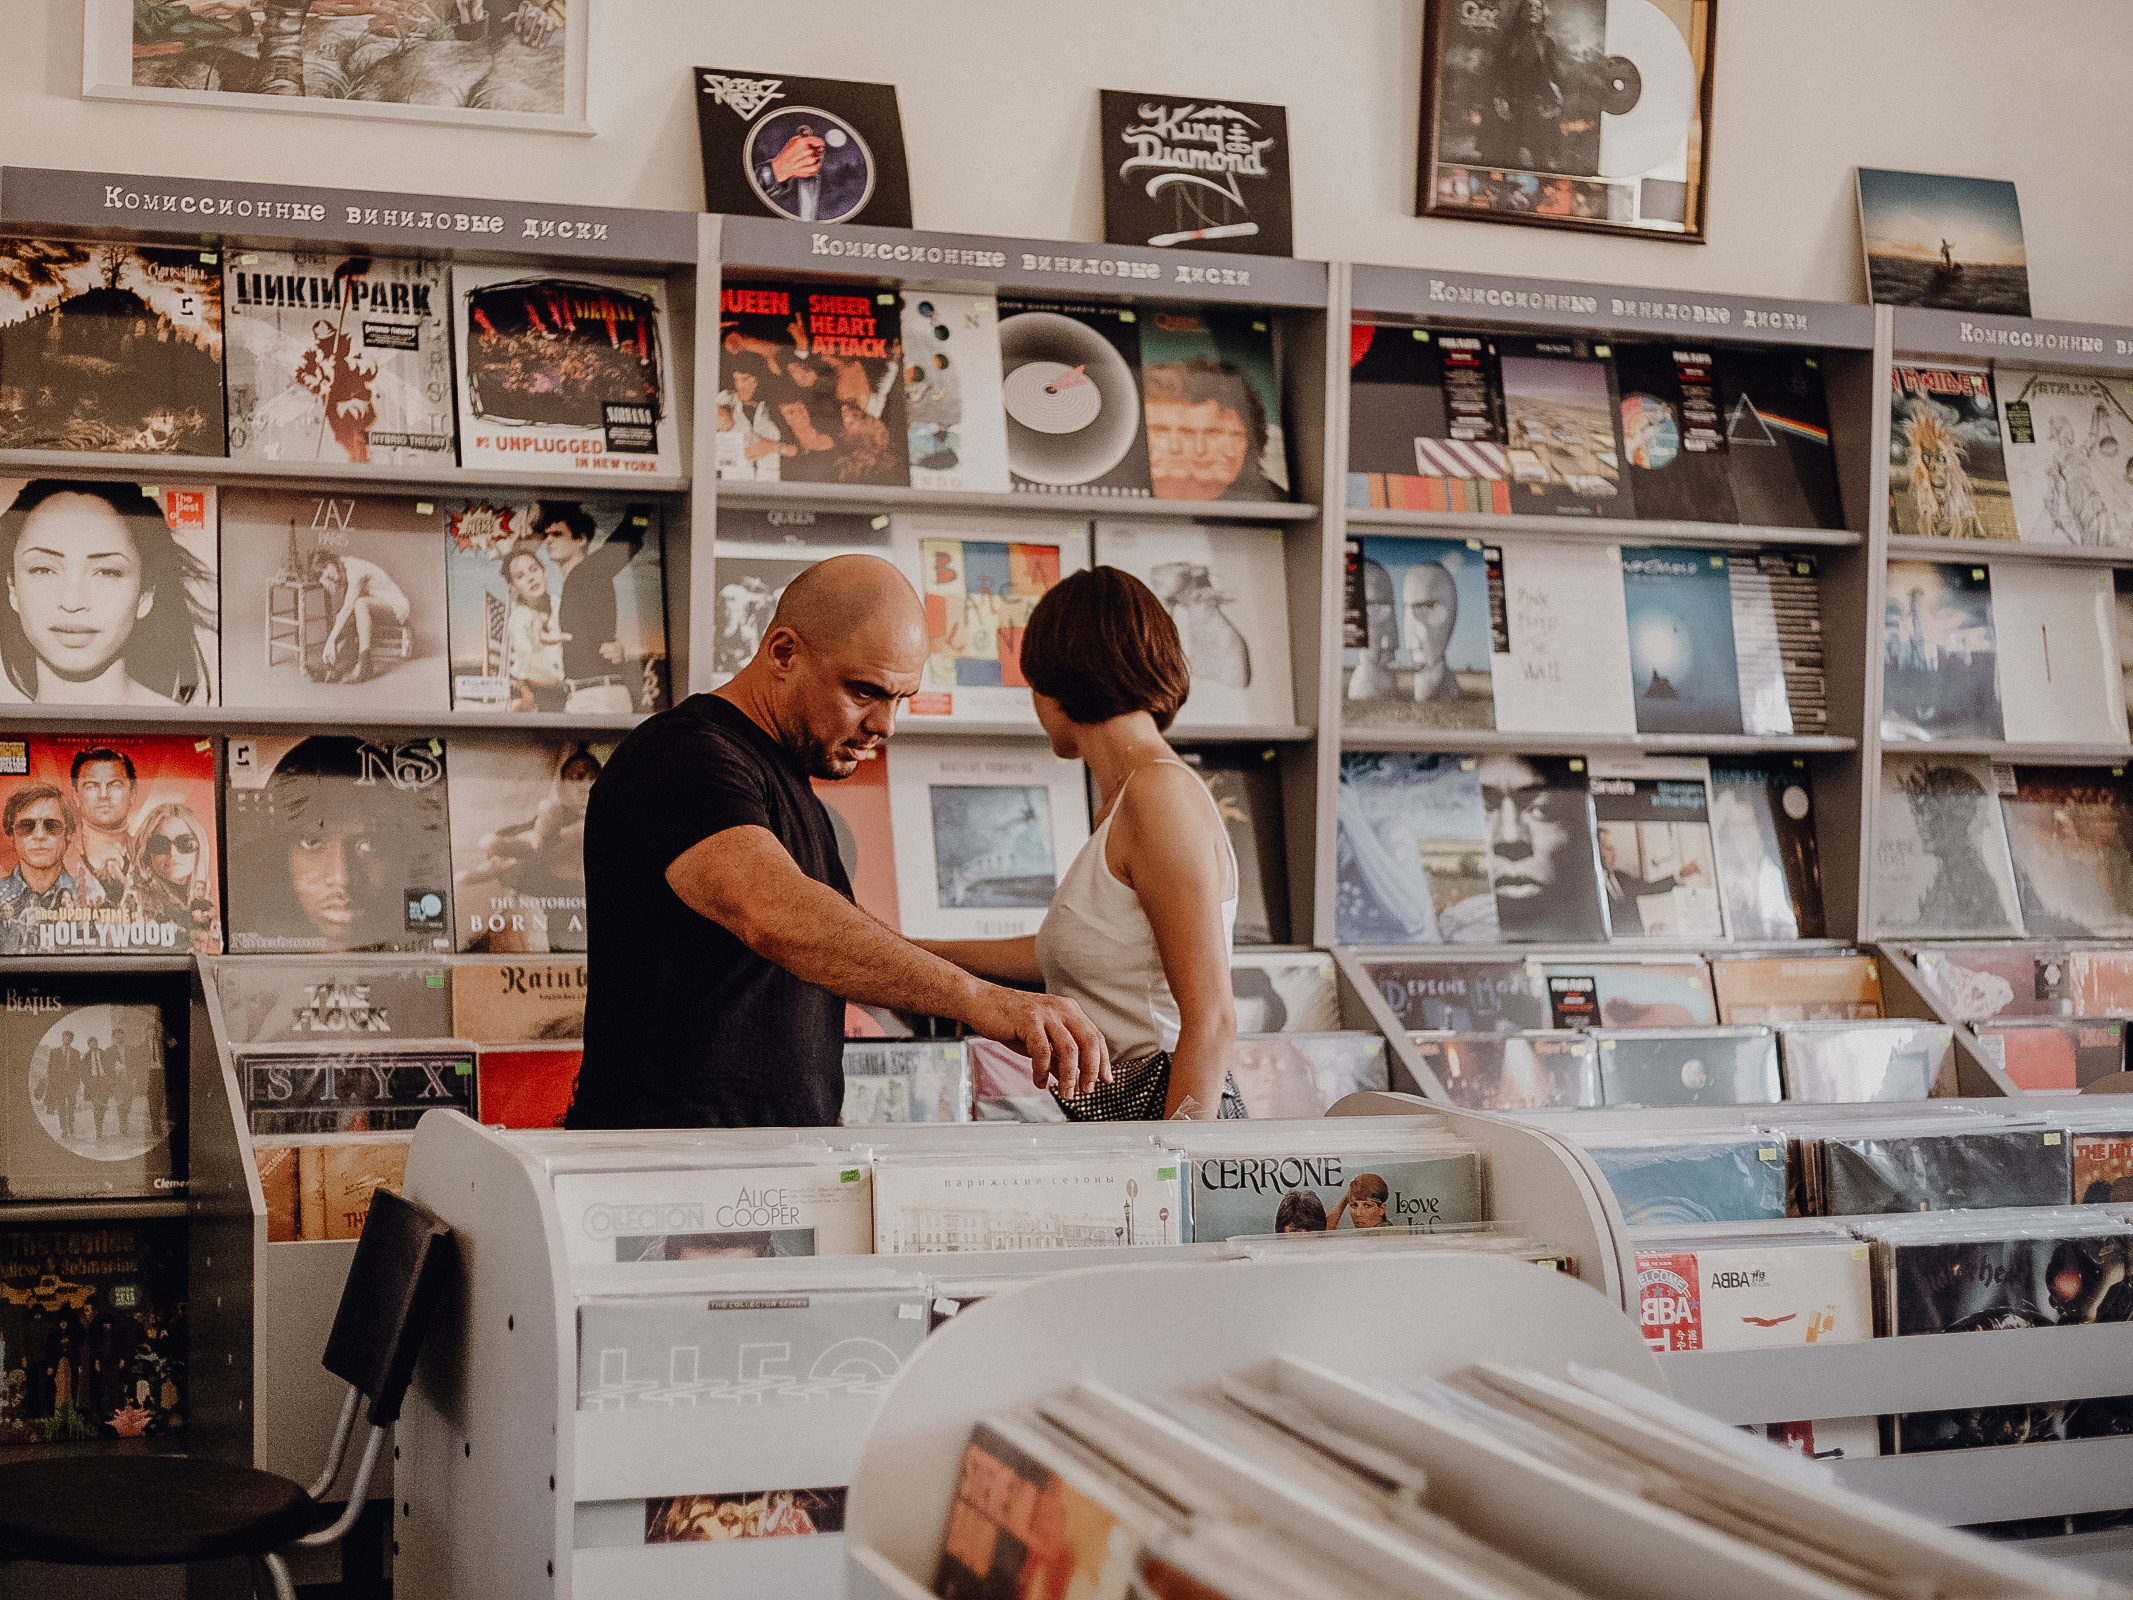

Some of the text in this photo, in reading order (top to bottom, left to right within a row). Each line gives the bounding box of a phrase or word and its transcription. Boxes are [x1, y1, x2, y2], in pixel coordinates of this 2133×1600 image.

[1125, 102, 1225, 151] King
[1119, 133, 1275, 178] Diamond
[103, 185, 610, 241] Комиссионные виниловые диски
[811, 233, 1251, 287] Комиссионные виниловые диски
[236, 272, 432, 317] LINKIN PARK
[808, 294, 871, 317] SHEER
[1428, 279, 1808, 332] Комиссионные виниловые диски
[809, 315, 877, 337] HEART
[1959, 322, 2104, 353] Комиссионные
[811, 336, 888, 359] ATTACK
[495, 436, 604, 455] UNPLUGGED
[592, 458, 620, 469] NEW
[624, 459, 657, 472] YORK
[489, 896, 587, 910] THE NOTORIO
[58, 907, 92, 921] UPON
[99, 908, 131, 924] TIME
[470, 913, 549, 933] BORN
[39, 920, 177, 949] HOLLYWOOD
[501, 966, 587, 994] Rainb
[6, 988, 62, 1016] BEATLES
[293, 1006, 391, 1032] FLOCK
[267, 1060, 452, 1101] STYX
[2076, 1144, 2105, 1160] THE
[944, 1174, 1116, 1189] парижские сезоны
[1200, 1156, 1344, 1196] CERRONE
[735, 1186, 788, 1209] ALICE
[1395, 1191, 1440, 1215] Love
[715, 1206, 800, 1228] COOPER
[1637, 1270, 1686, 1291] ELCOME
[1711, 1271, 1751, 1289] ABBA
